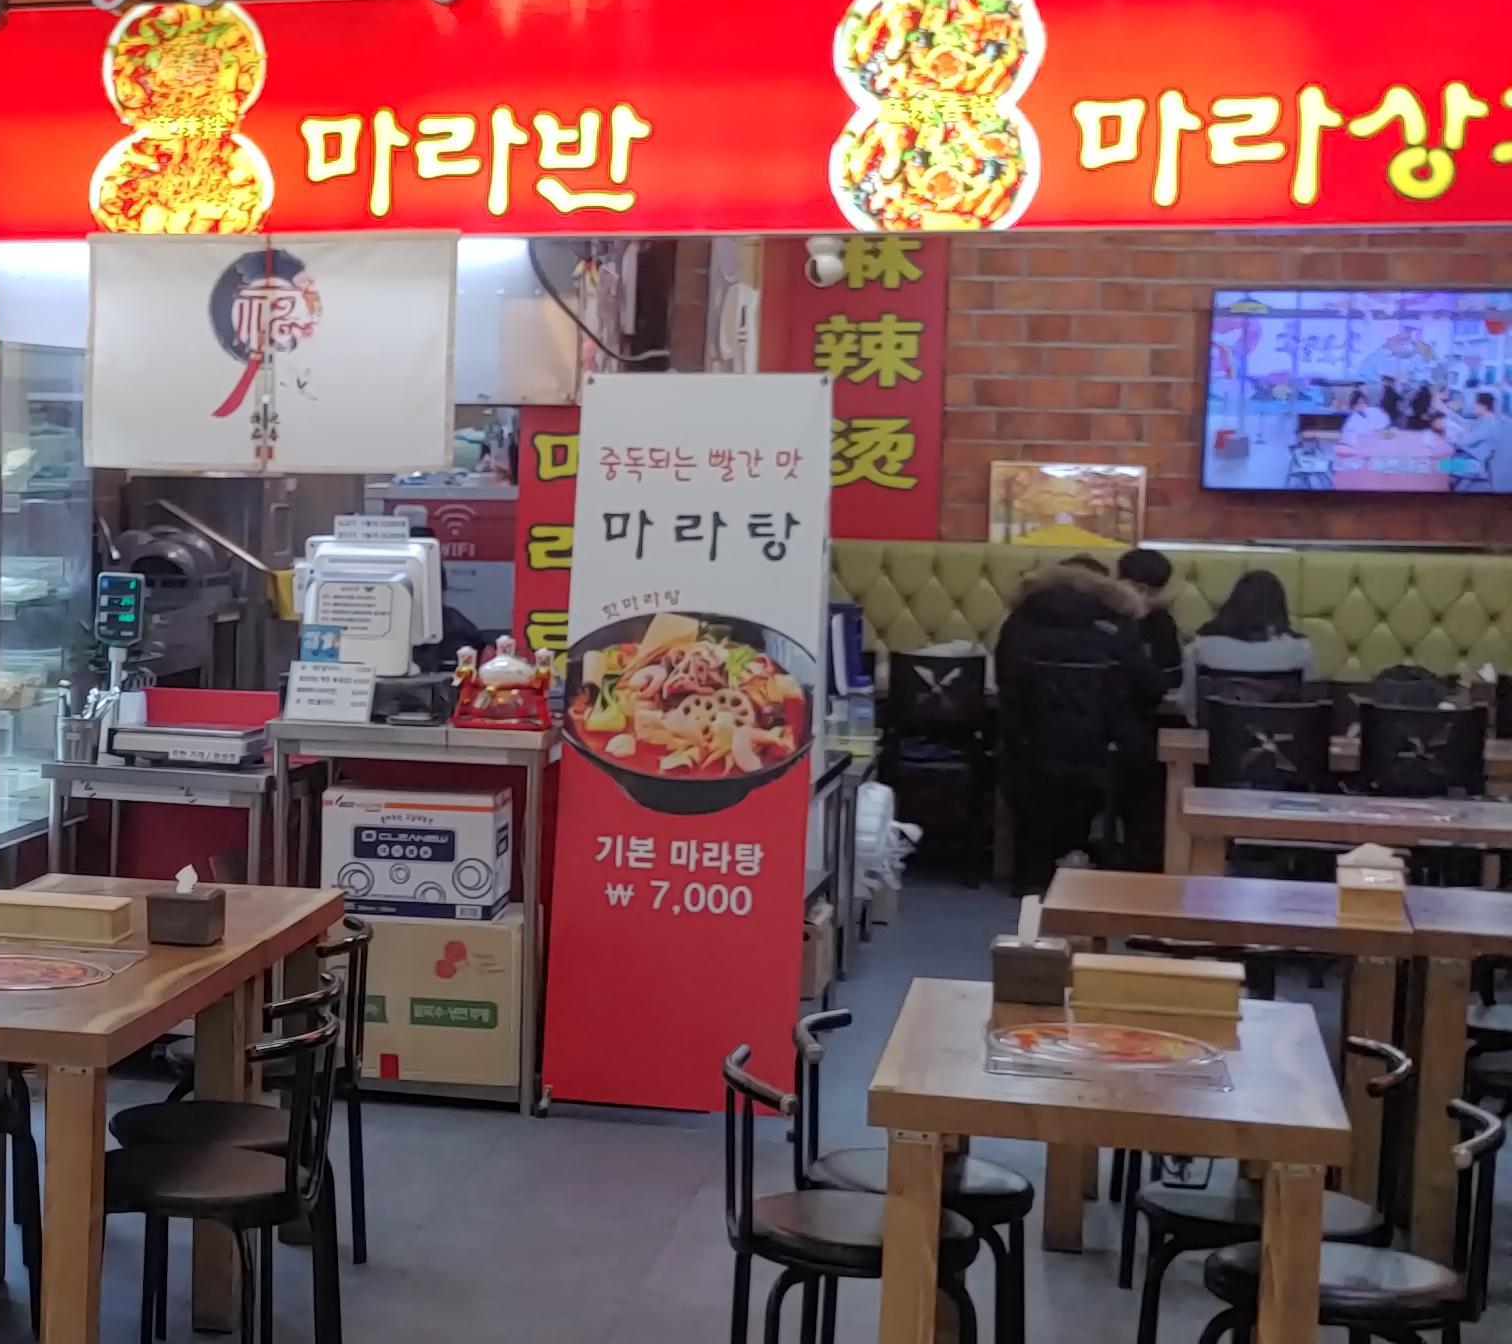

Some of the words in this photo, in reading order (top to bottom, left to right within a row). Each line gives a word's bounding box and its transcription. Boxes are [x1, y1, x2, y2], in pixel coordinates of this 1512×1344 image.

[300, 103, 653, 217] 마라반
[1072, 81, 1512, 207] 마라상
[599, 447, 697, 483] 중독되는
[708, 447, 764, 483] 빨간
[775, 448, 804, 480] 맛
[602, 509, 801, 562] 마라탕
[594, 834, 657, 869] 기본
[669, 839, 765, 877] 마라탕
[649, 880, 753, 916] 7,000
